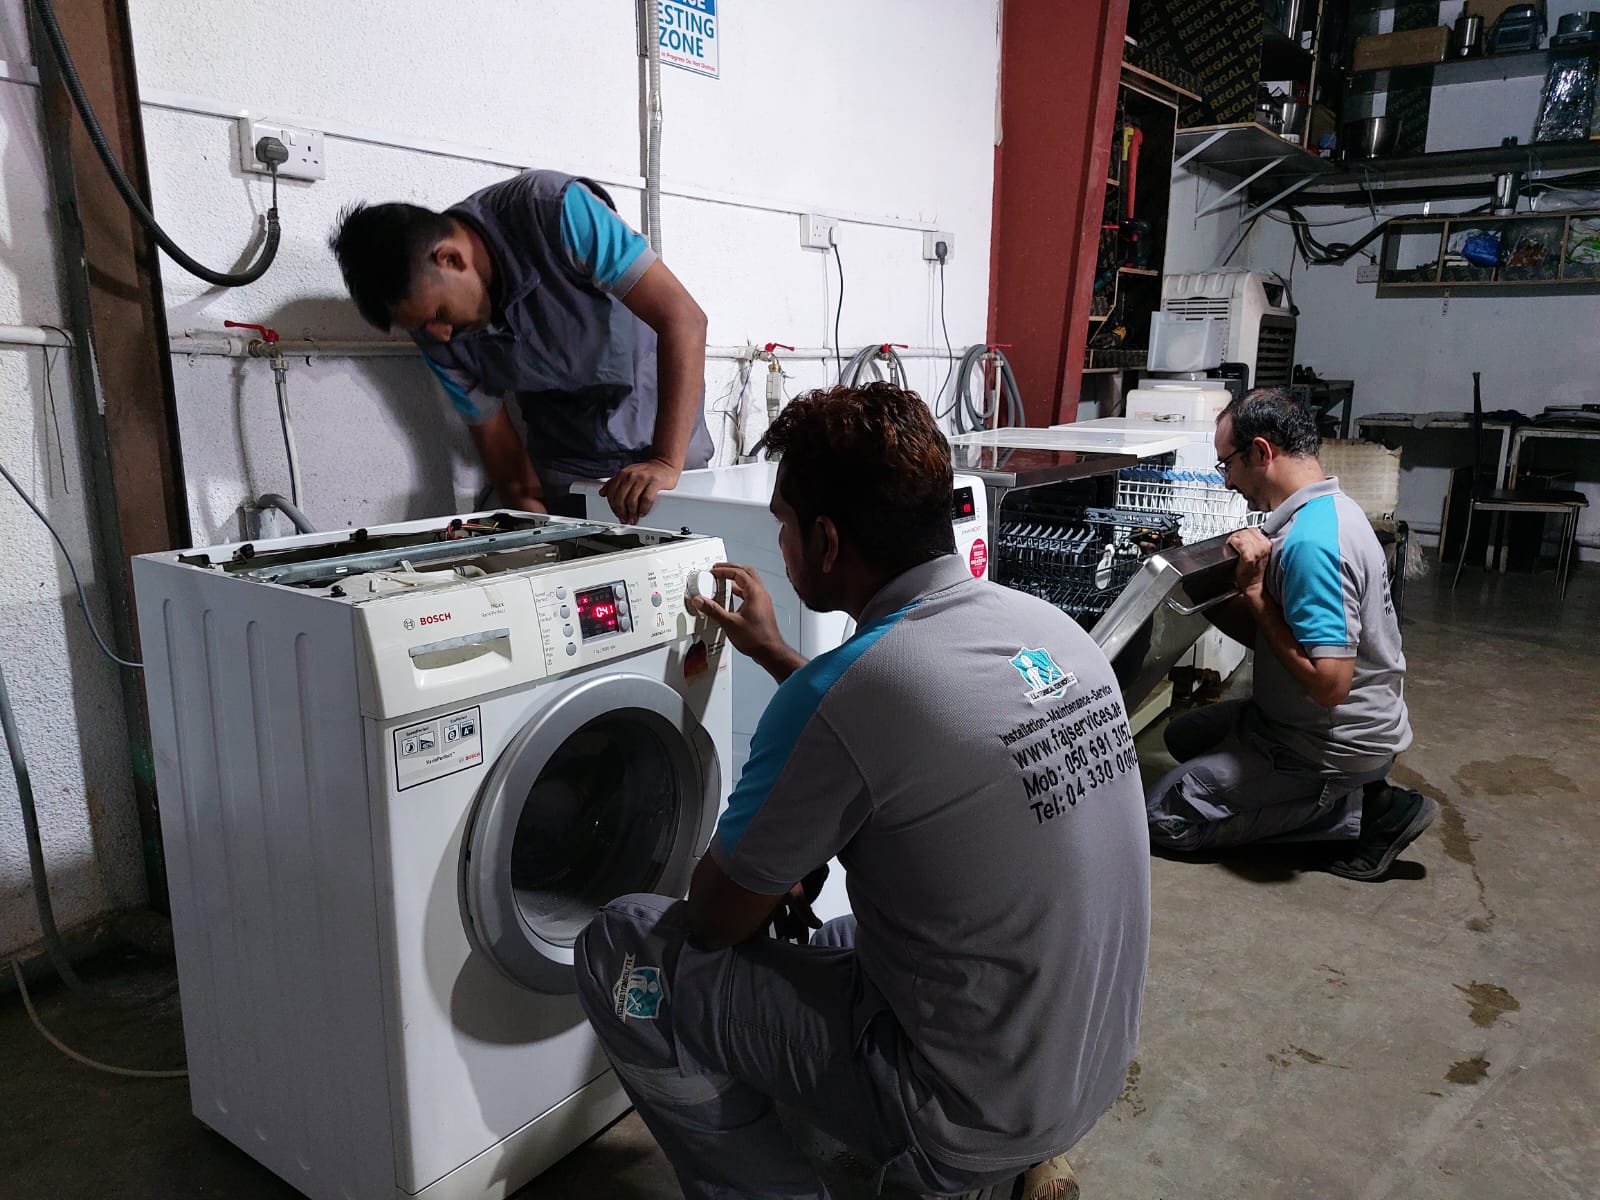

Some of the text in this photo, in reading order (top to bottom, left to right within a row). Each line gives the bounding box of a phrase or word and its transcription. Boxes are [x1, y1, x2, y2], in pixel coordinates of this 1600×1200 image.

[1177, 10, 1218, 40] REGAL
[1184, 0, 1259, 54] REGAL PLEX
[1190, 12, 1265, 67] REGAL PLEX
[659, 26, 704, 57] ZONE
[1198, 51, 1238, 80] REGAL
[1203, 65, 1245, 95] REGAL
[1210, 79, 1251, 109] REGAL
[1216, 94, 1256, 123] REGAL
[420, 613, 451, 626] BOSCH
[999, 684, 1112, 747] Installation-Maintenance-Service
[1012, 702, 1121, 769] www.fajservices.ae
[465, 753, 480, 761] BOSCH
[1065, 747, 1087, 775] 050
[1090, 731, 1112, 759] 691
[1067, 777, 1085, 806] 04
[1090, 760, 1113, 789] 330
